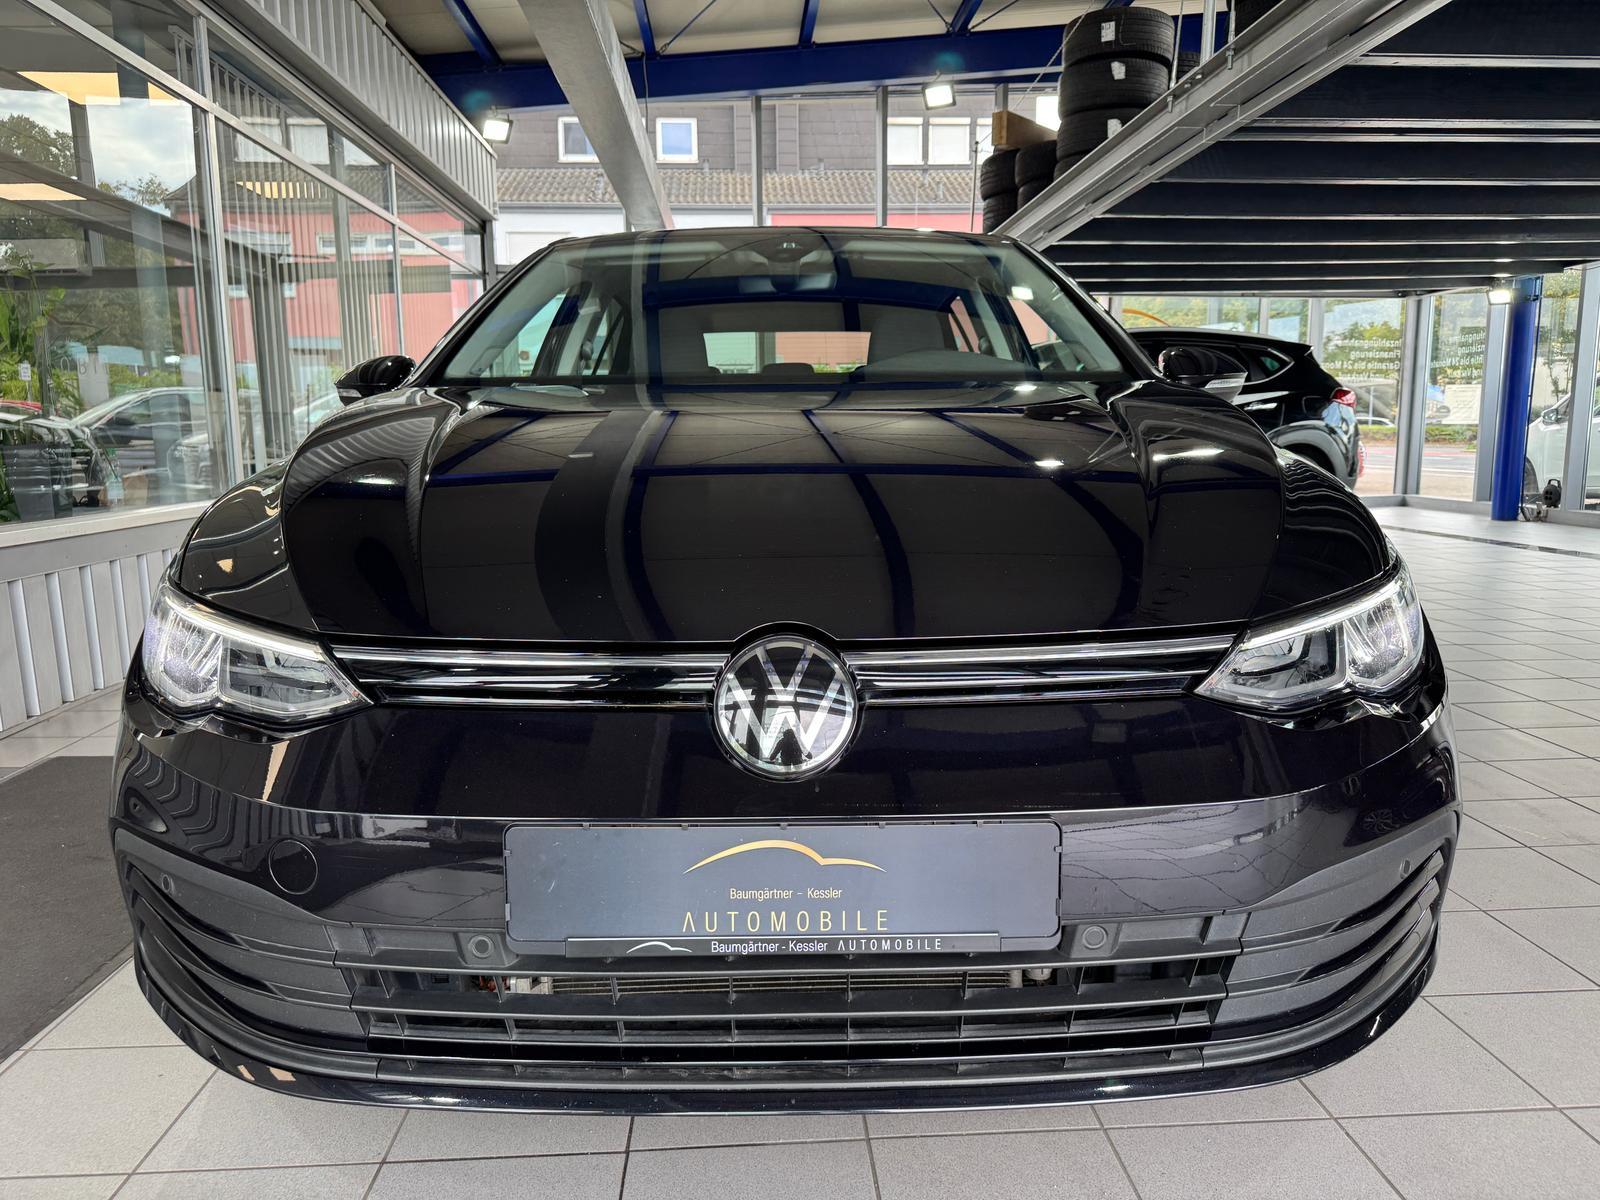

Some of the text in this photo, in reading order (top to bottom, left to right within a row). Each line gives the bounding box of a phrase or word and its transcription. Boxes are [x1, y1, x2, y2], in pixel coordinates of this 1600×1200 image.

[729, 887, 794, 902] Baumgärtner
[807, 887, 843, 899] Kessler
[682, 910, 889, 933] AUTOMOBILE
[711, 941, 780, 955] Baumgärtner
[788, 939, 829, 952] Kessler
[837, 938, 944, 951] AUTOMOBILE
